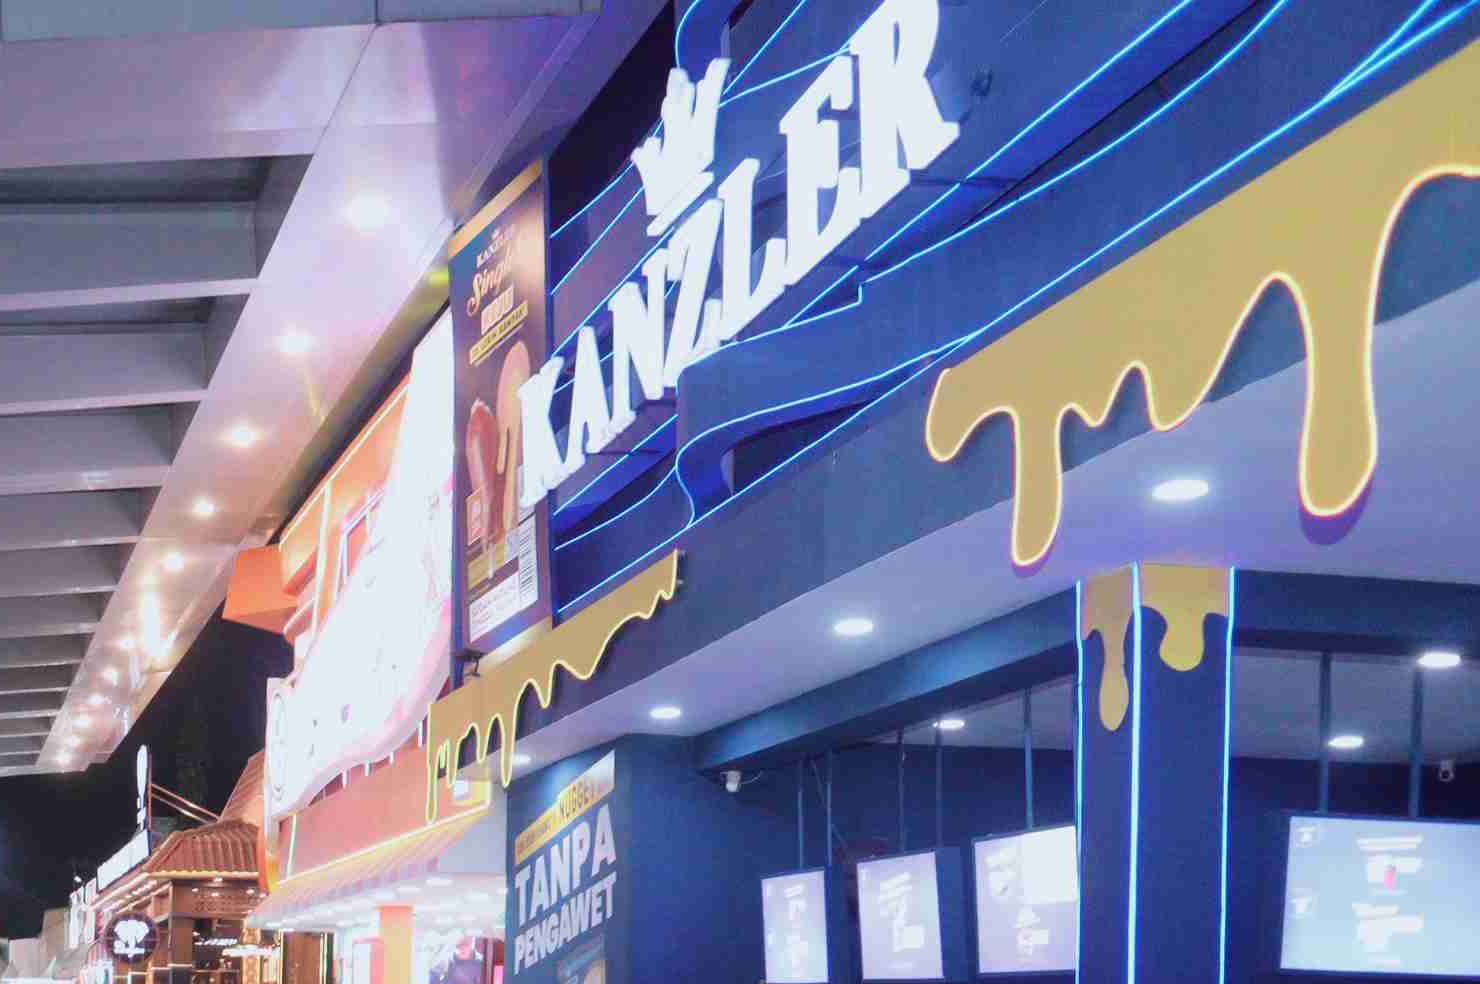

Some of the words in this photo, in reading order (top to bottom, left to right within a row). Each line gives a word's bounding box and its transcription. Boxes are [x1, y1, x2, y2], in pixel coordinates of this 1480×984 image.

[517, 0, 960, 508] KANZLER
[514, 872, 617, 976] PENGAWET
[515, 804, 616, 927] TANPA
